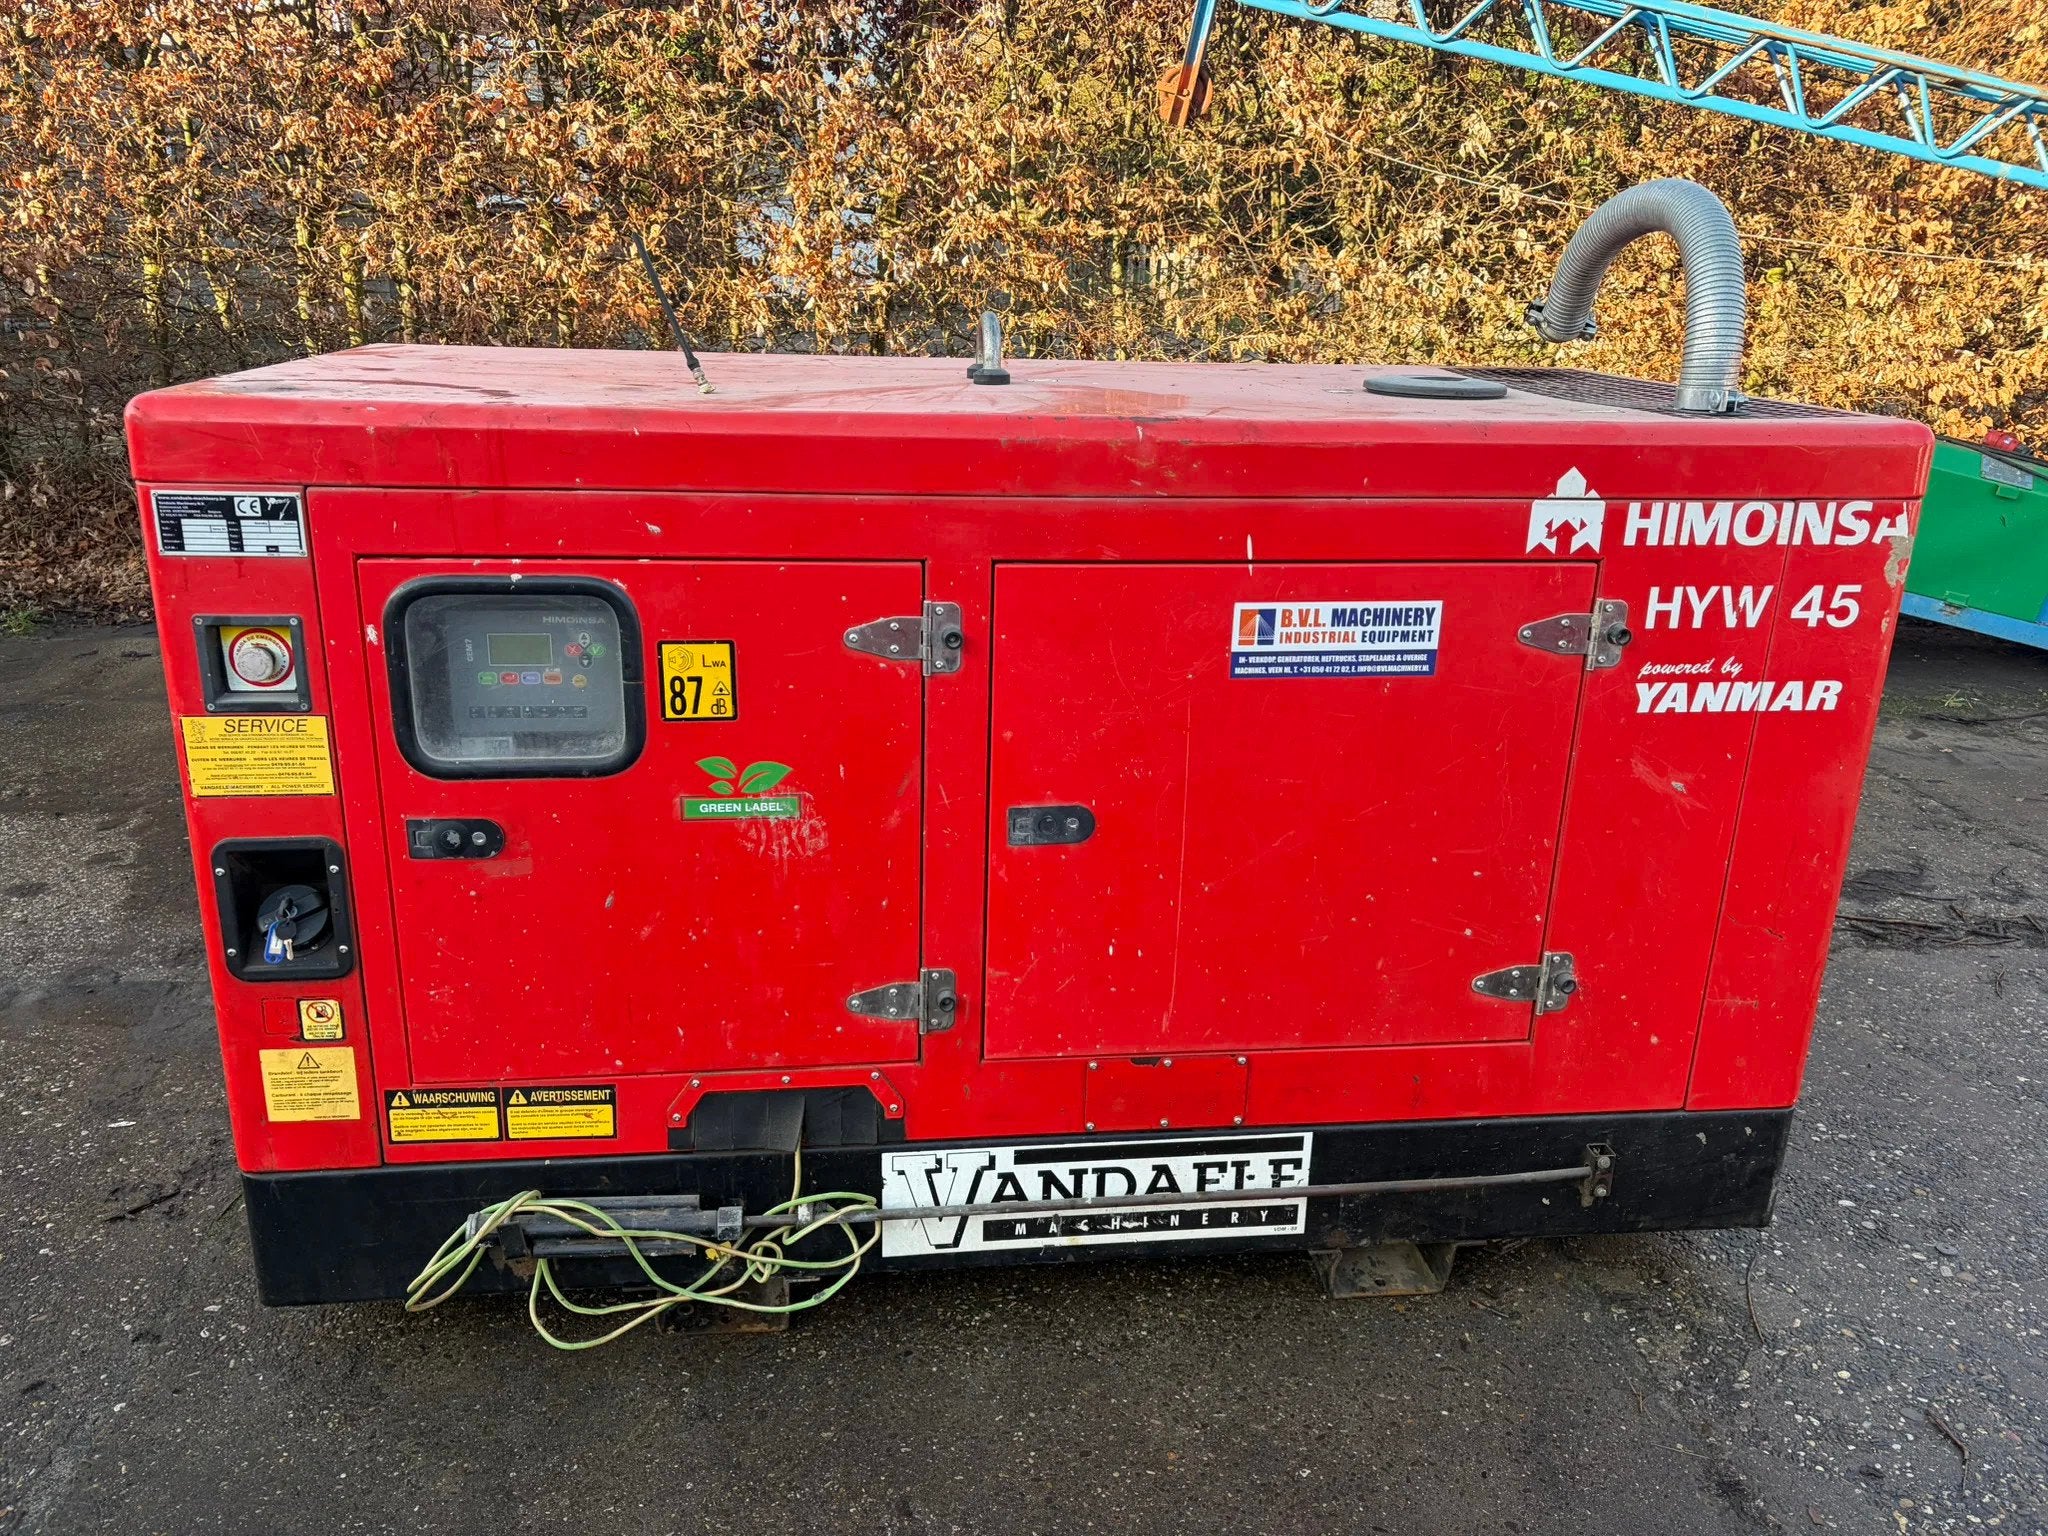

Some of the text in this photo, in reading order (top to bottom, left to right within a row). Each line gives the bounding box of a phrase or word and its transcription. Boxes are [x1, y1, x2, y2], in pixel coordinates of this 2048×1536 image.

[237, 499, 259, 514] CE
[1623, 501, 1910, 546] HIMOINSA
[1644, 584, 1862, 629] HYW 45
[543, 616, 606, 624] HIMOINSA
[1281, 607, 1436, 628] B.V.L. MACHINERY
[1279, 630, 1434, 644] INDUSTRIAL EQUIPMENT
[465, 638, 474, 662] CEM7
[1358, 654, 1395, 662] STAPELAARS
[1402, 653, 1428, 661] OVERIGE
[1267, 666, 1283, 674] VEEN
[1325, 665, 1333, 673] 41
[1333, 665, 1340, 673] 72
[1357, 664, 1429, 672] INFO@BVLMACHINERY.NL
[1638, 655, 1744, 680] powered by
[669, 675, 703, 716] 87
[1635, 680, 1843, 714] YANMAR
[711, 698, 728, 715] dB
[223, 719, 308, 733] SERVICE
[699, 801, 784, 813] GREEN LABEL
[412, 1091, 496, 1104] WAARSCHUWING
[530, 1089, 611, 1102] AVERTISSEMENT
[1014, 1209, 1268, 1236] MACHINERY
